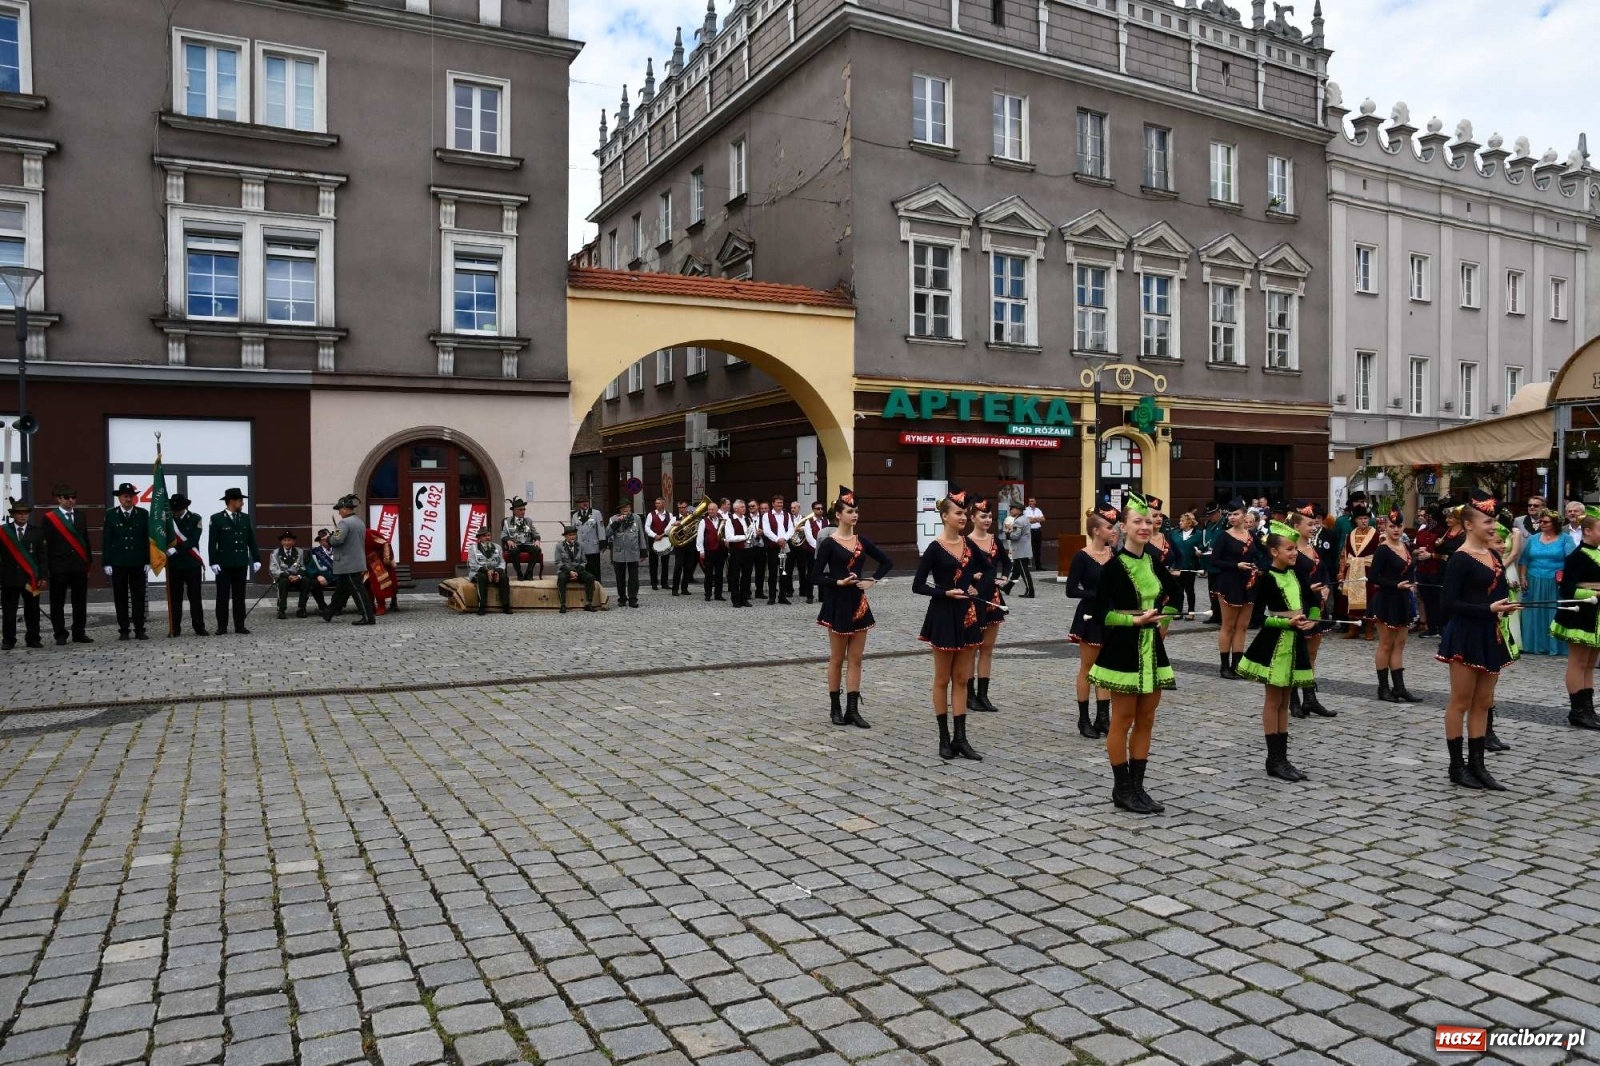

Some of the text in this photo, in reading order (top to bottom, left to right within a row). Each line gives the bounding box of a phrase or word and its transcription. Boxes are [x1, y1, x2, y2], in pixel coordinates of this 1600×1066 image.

[882, 388, 1074, 425] APTEKA
[905, 434, 934, 443] RYNEK
[951, 436, 989, 445] CENTRUM
[990, 437, 1058, 447] FARMACEUTYCZNE
[1012, 426, 1071, 436] POD RÓŻAMI
[415, 534, 434, 558] 602
[426, 484, 444, 509] 432
